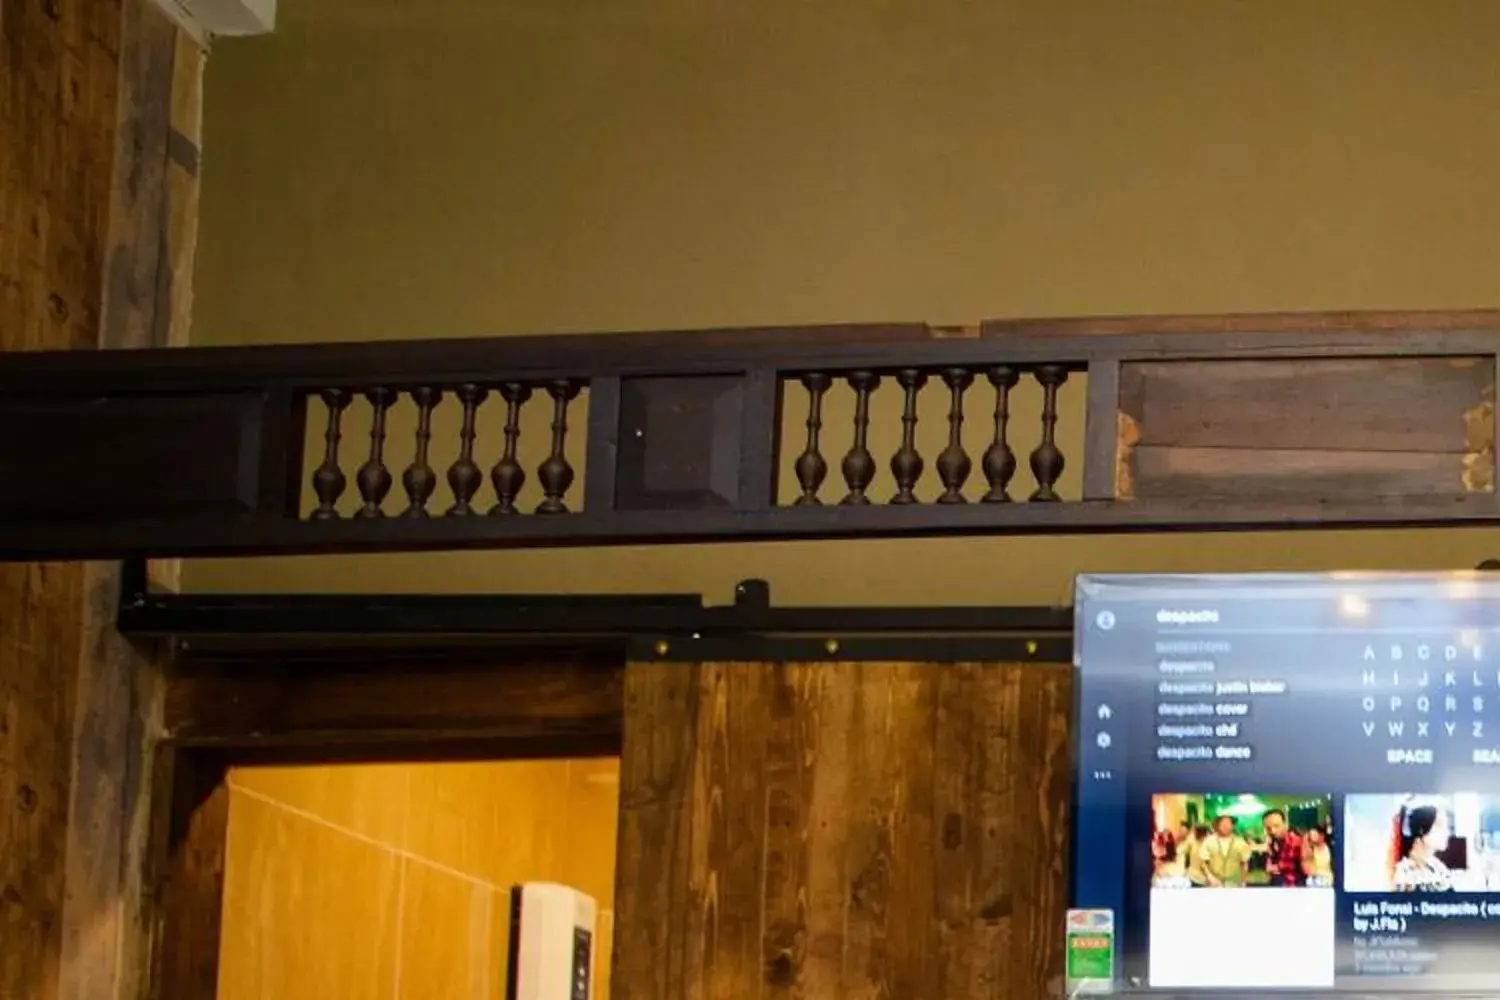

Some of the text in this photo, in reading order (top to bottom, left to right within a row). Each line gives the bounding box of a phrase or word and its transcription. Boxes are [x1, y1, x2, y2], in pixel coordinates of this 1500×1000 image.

[1362, 670, 1375, 686] H
[1393, 670, 1399, 686] I
[1418, 670, 1429, 686] J
[1445, 670, 1457, 686] K
[1473, 670, 1483, 686] L
[1362, 696, 1375, 712] O
[1391, 696, 1402, 712] P
[1417, 696, 1430, 712] Q
[1445, 696, 1457, 712] R
[1472, 696, 1484, 712] S
[1362, 721, 1375, 737] V
[1388, 721, 1403, 737] W
[1417, 721, 1429, 737] X
[1444, 721, 1457, 737] Y
[1472, 721, 1484, 737] Z
[1387, 749, 1433, 764] SPACE
